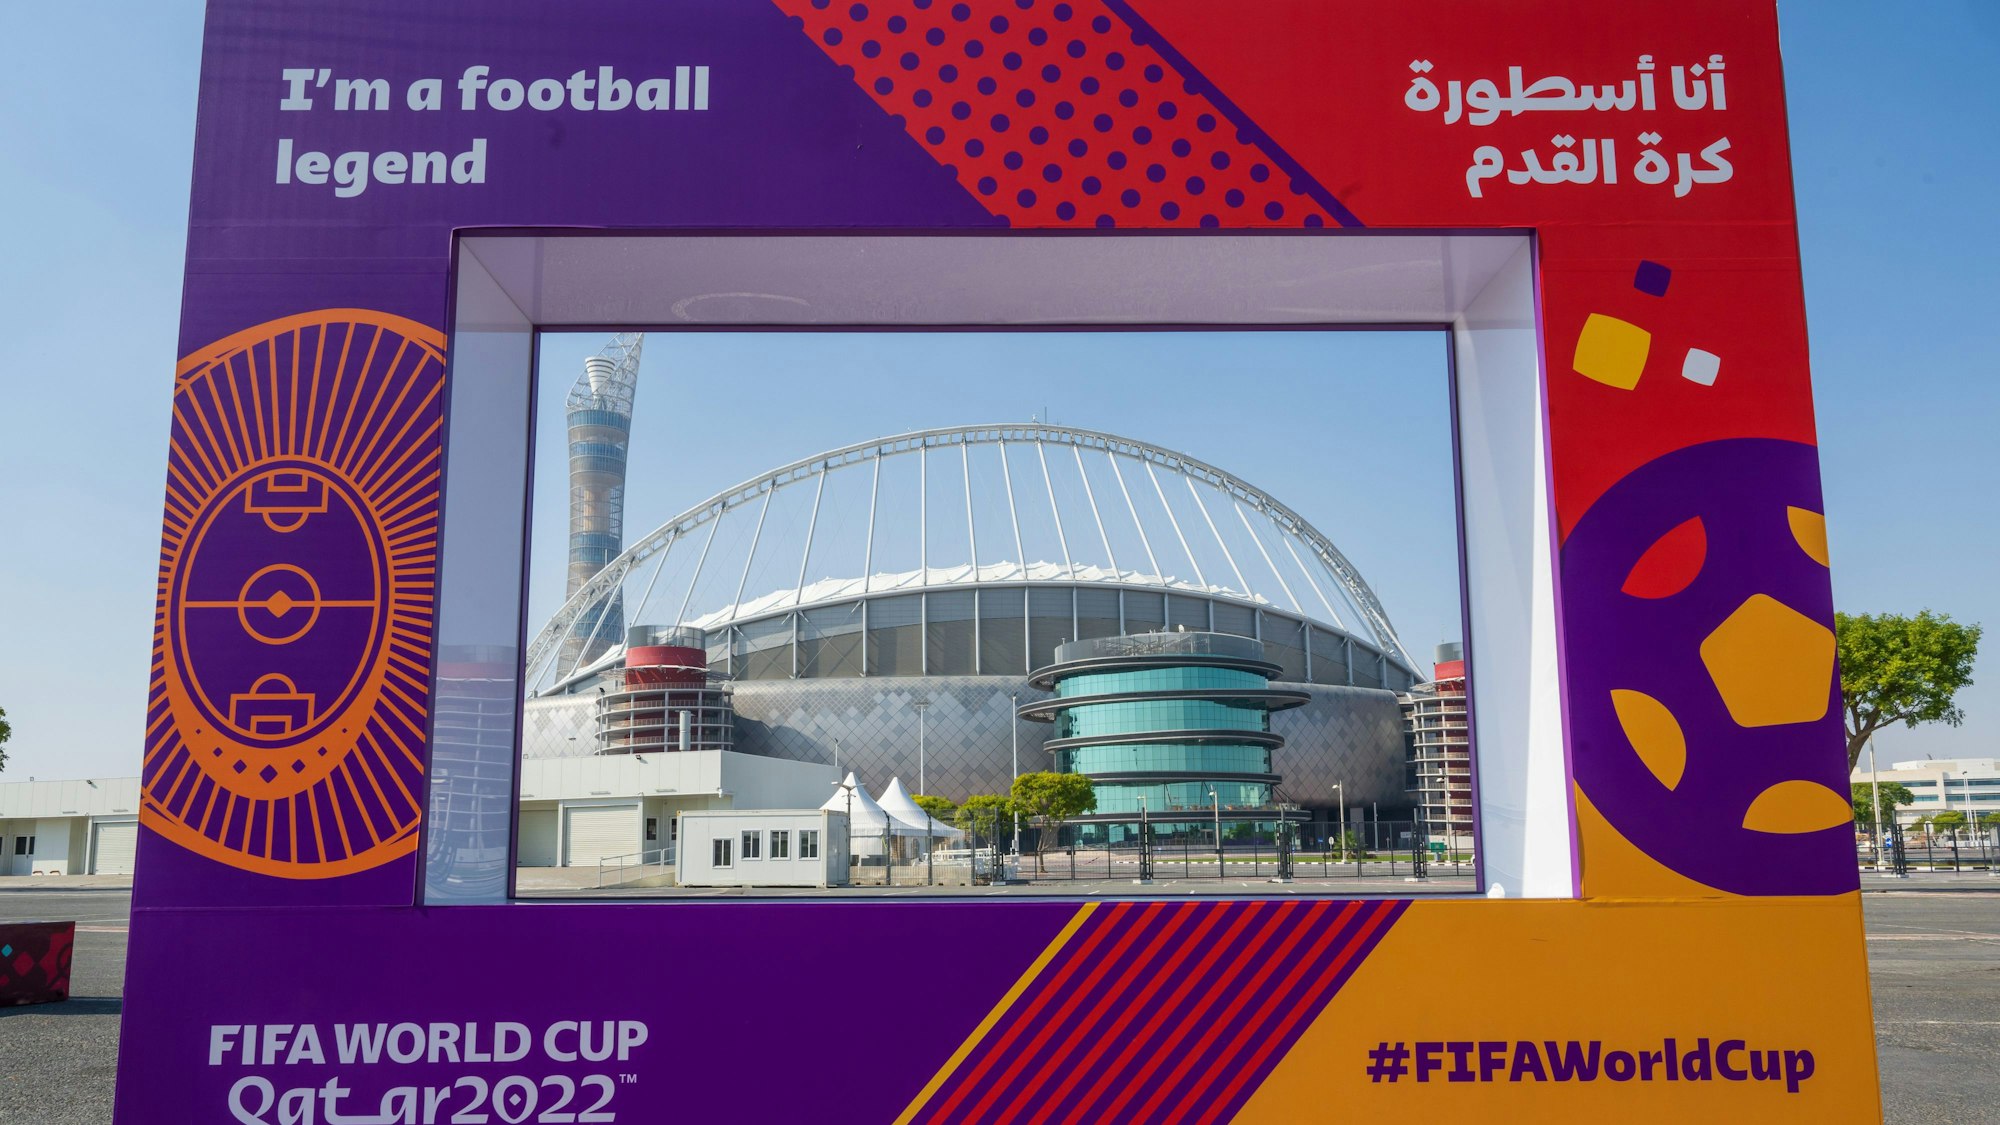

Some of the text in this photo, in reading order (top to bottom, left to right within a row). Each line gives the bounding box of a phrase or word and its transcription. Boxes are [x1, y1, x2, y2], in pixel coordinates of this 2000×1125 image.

[279, 65, 711, 112] I'm a football
[1404, 54, 1728, 127] أنا أسطورة
[275, 138, 488, 199] legend
[1465, 131, 1735, 198] كرة القدم
[208, 1020, 650, 1066] FIFA WORLD CUP
[1365, 1036, 1816, 1094] #FIFAWorldCup
